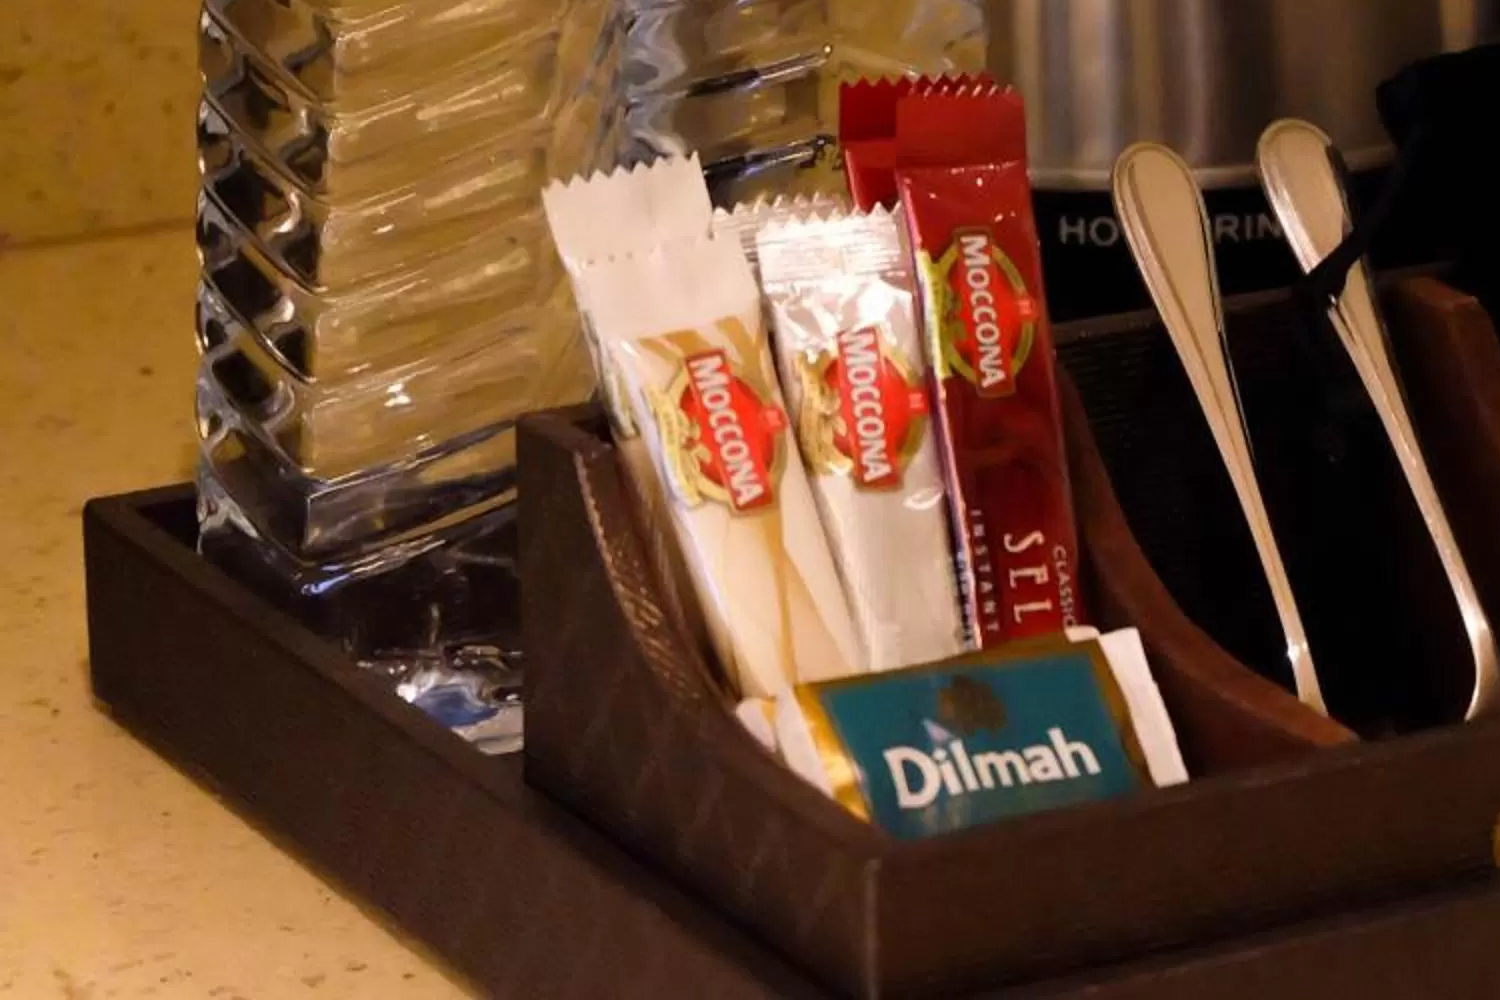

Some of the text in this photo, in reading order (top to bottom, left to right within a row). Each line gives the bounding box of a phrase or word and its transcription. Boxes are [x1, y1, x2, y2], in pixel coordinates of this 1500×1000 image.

[959, 234, 1006, 389] MOCCONA
[687, 355, 765, 507] MOCCONA
[839, 328, 893, 484] MOCCONA
[970, 508, 1000, 632] INSTANT
[883, 726, 1101, 809] Dilmah
